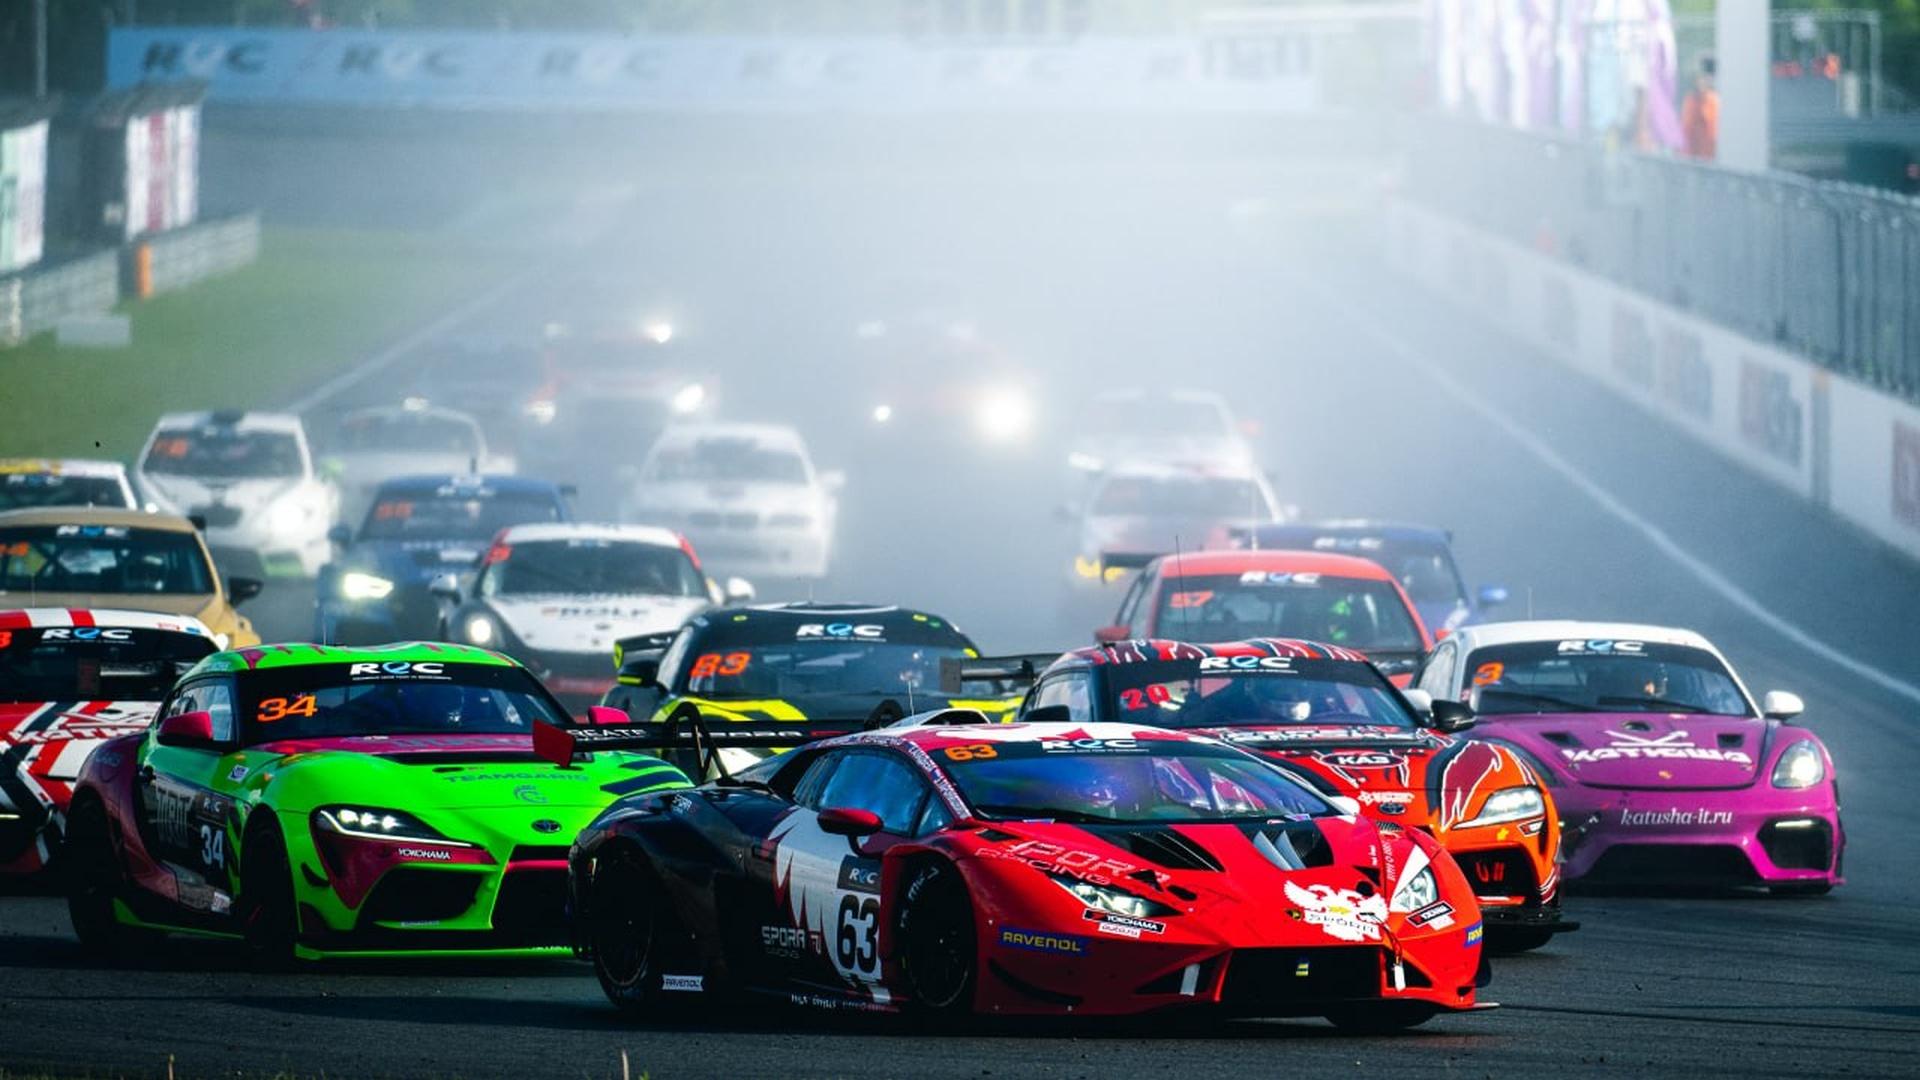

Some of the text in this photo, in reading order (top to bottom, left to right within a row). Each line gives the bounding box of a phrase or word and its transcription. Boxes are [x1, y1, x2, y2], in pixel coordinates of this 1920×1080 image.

[1473, 661, 1504, 686] 3
[258, 695, 317, 721] 34
[944, 744, 998, 761] 63
[1620, 807, 1733, 826] katusha-it.ru
[201, 825, 225, 870] 34
[398, 847, 452, 860] YOKOHAMA
[761, 926, 806, 949] SPORA
[836, 894, 881, 974] 63
